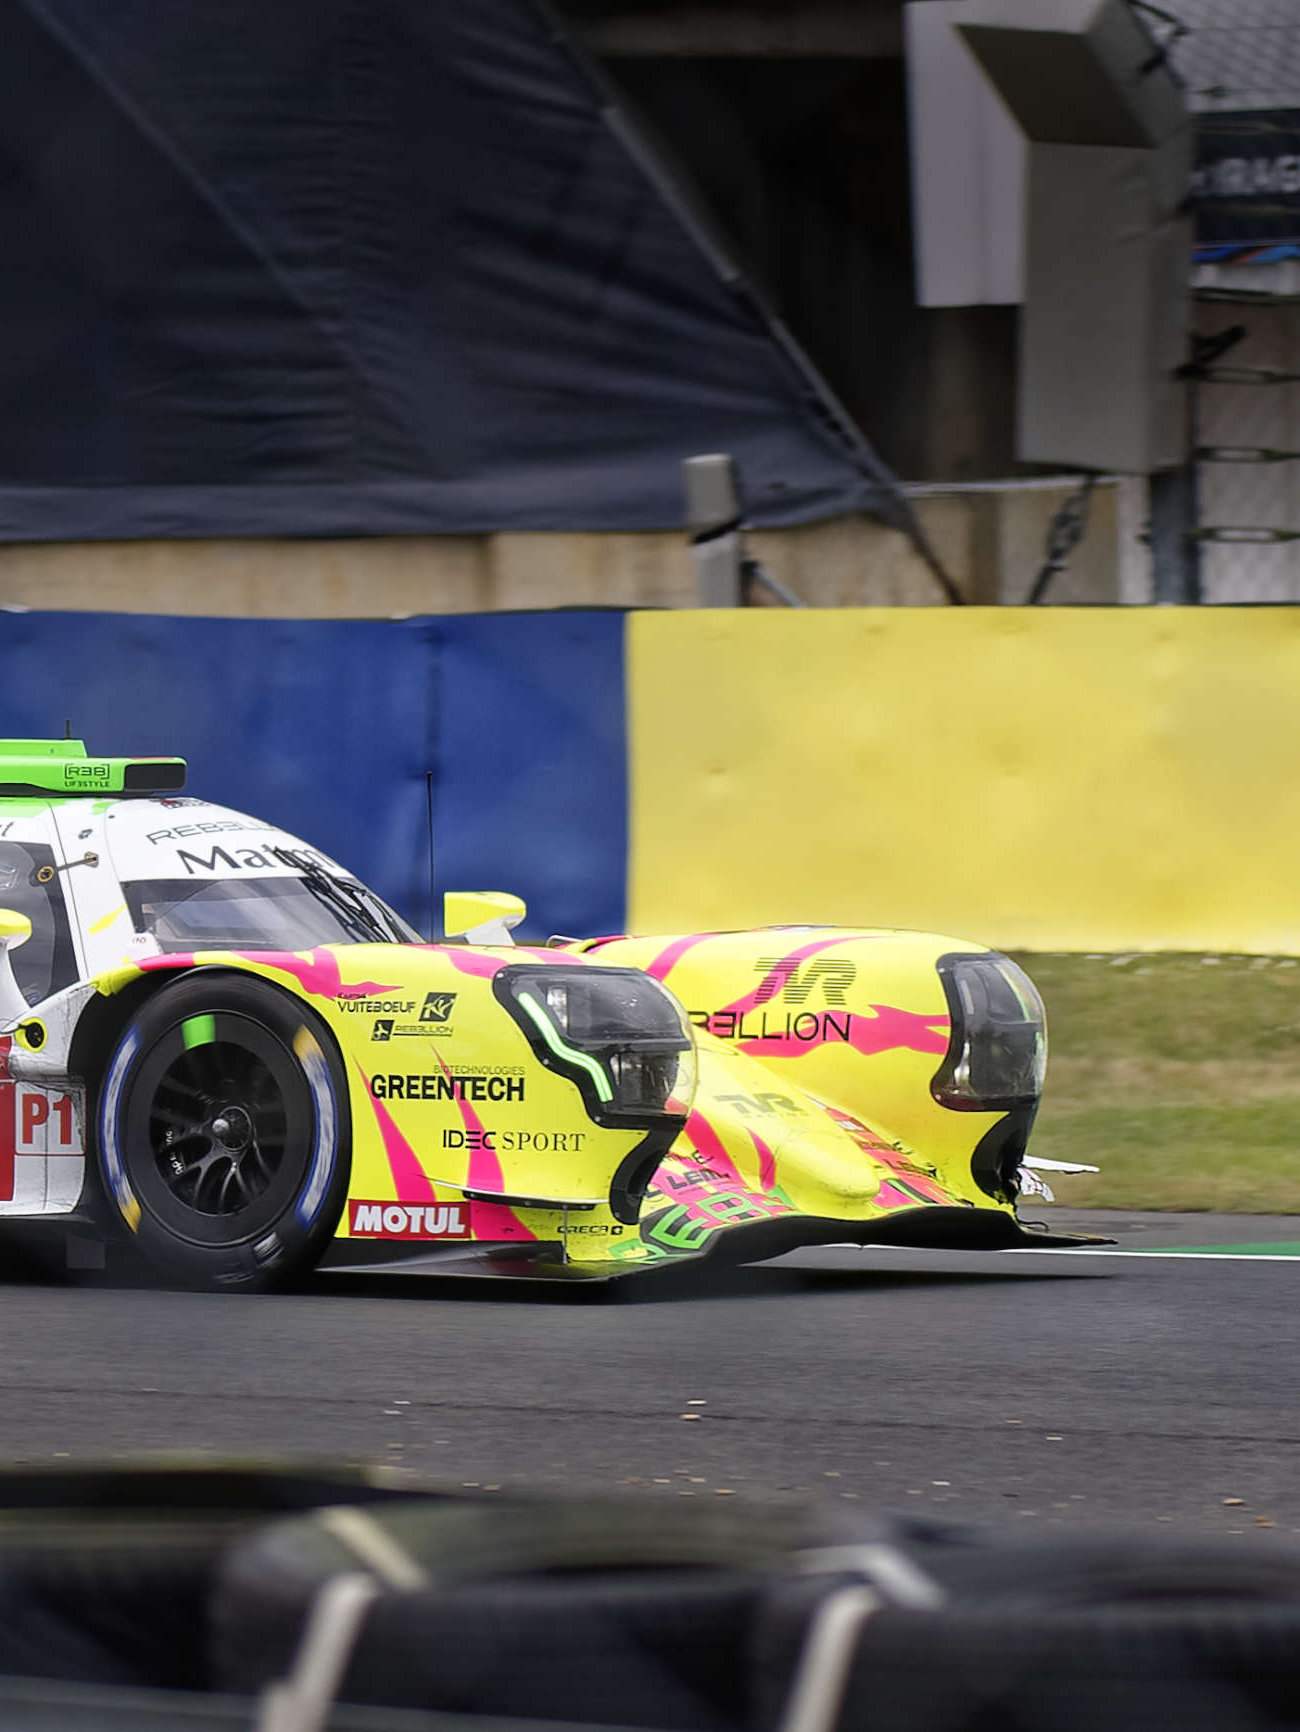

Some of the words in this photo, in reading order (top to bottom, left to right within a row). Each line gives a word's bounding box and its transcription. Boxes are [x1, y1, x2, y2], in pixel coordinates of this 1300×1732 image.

[753, 957, 857, 1006] TVR
[337, 1001, 417, 1013] VUITEBOEUF
[686, 1010, 852, 1041] BELLION
[434, 1065, 525, 1075] BIOTECHNOLOGIES
[371, 1074, 525, 1101] GREENTECH
[22, 1094, 72, 1145] P1
[443, 1129, 496, 1150] IDEC
[502, 1131, 586, 1151] SPORT
[353, 1205, 466, 1234] MOTUL
